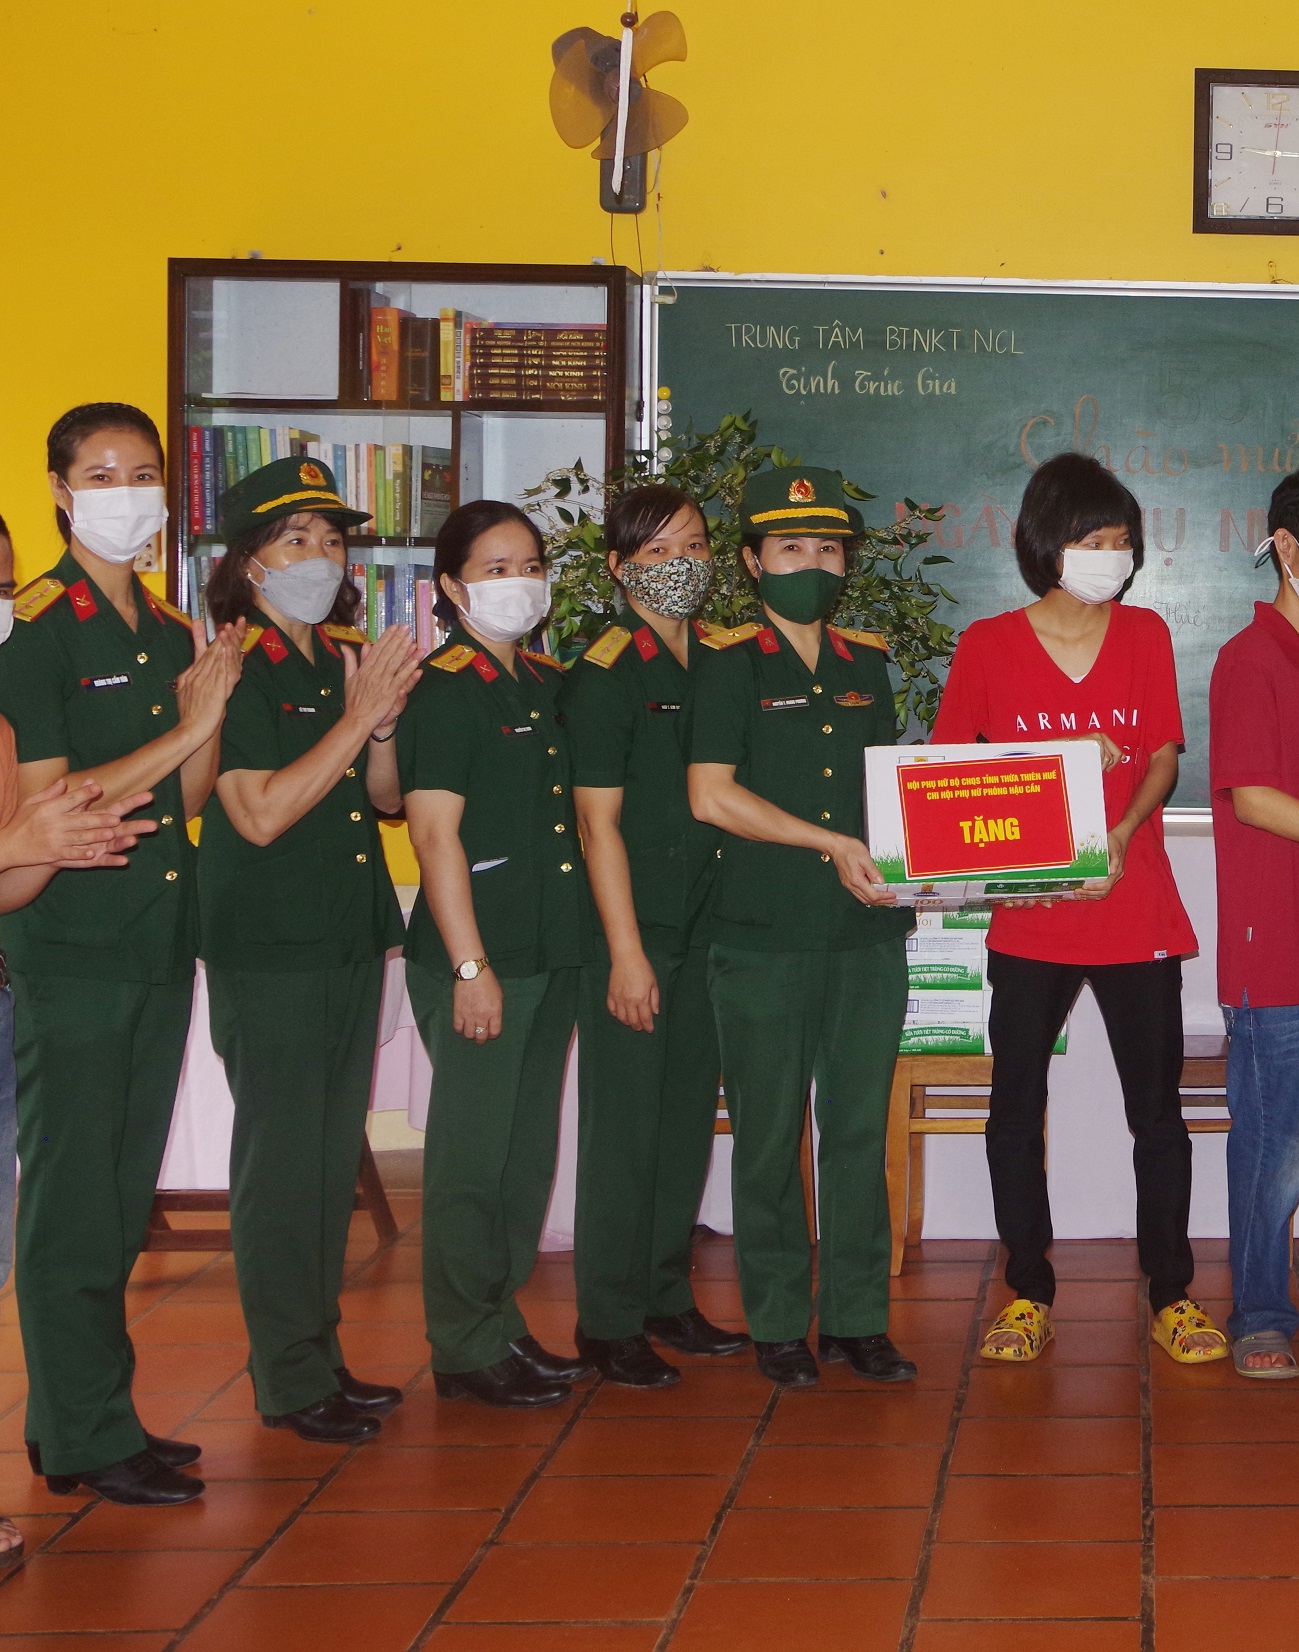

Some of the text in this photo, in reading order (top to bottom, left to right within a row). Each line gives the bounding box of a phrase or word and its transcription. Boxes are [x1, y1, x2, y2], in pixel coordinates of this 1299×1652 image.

[1264, 93, 1290, 111] 12
[1215, 143, 1232, 160] 9
[1266, 197, 1283, 214] 6
[725, 319, 1024, 354] TRUNG TÂM BTNKT NCL
[854, 366, 904, 396] Trúc
[917, 366, 957, 396] Gia
[1016, 708, 1138, 732] ARMANI
[961, 776, 981, 786] CHQS
[927, 791, 939, 800] CHI
[959, 815, 1021, 848] TẶNG
